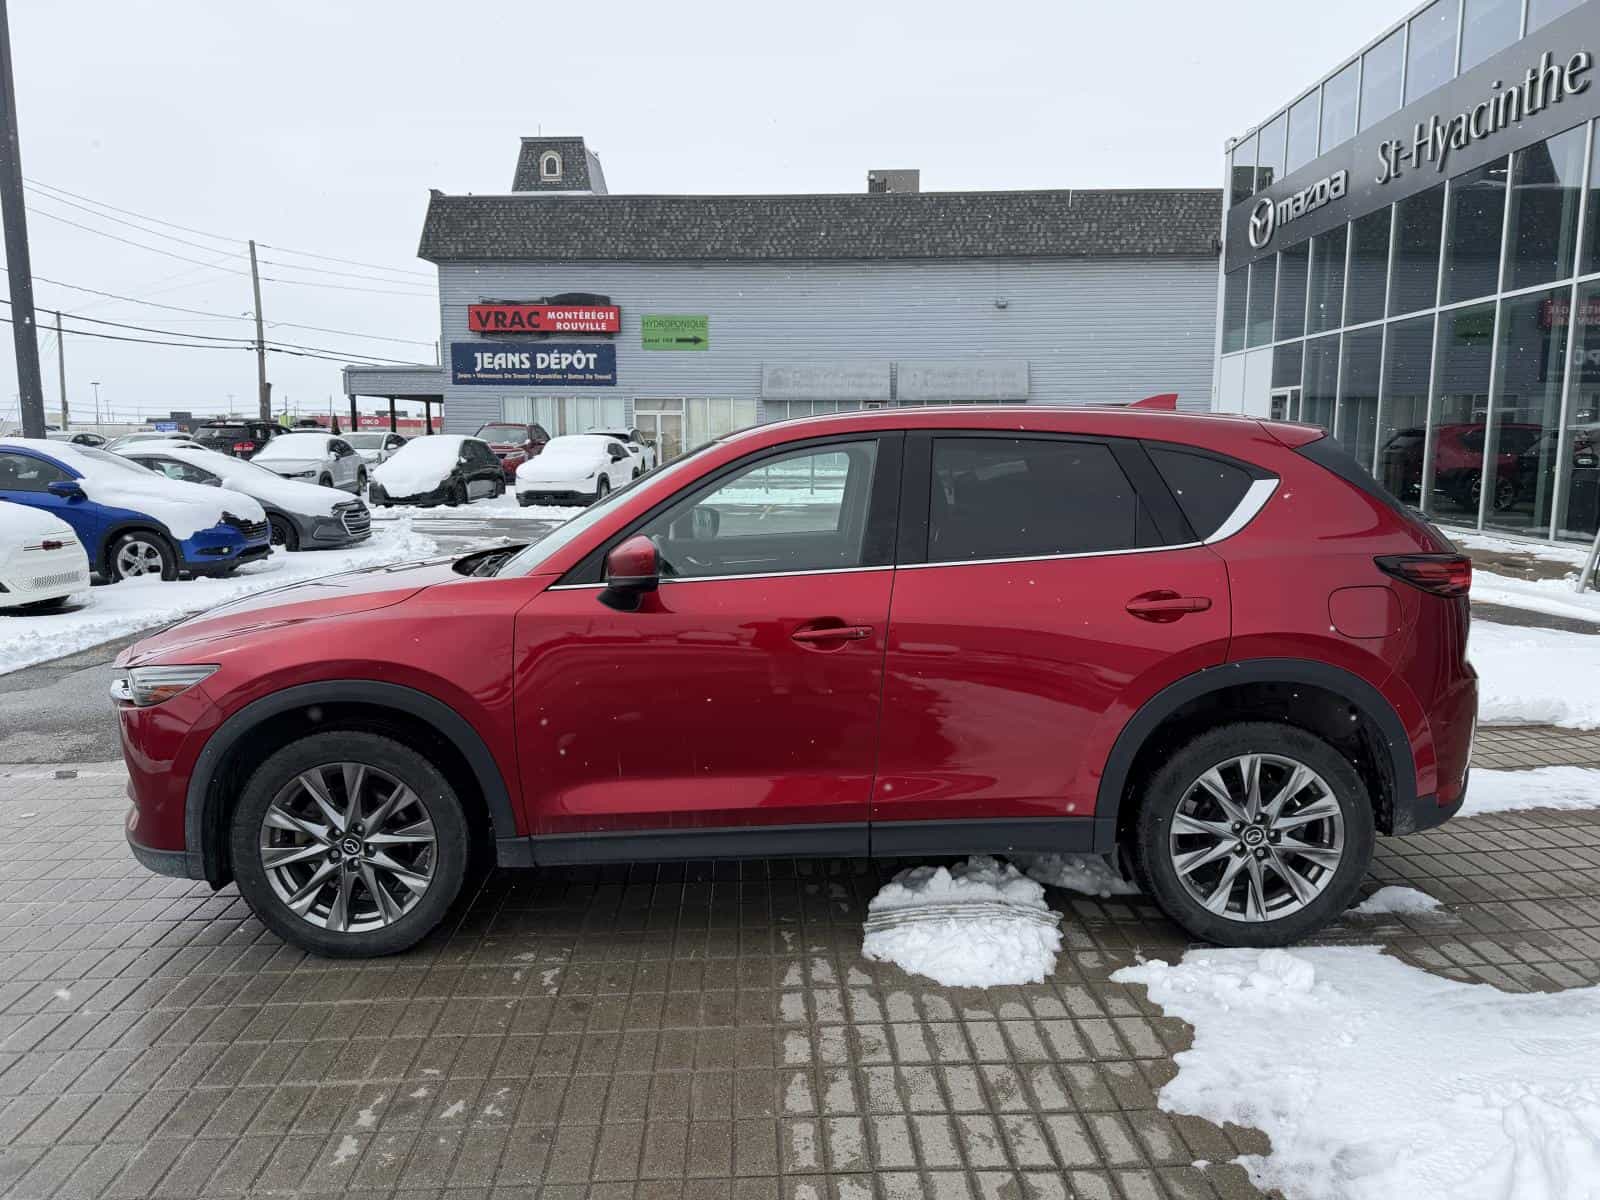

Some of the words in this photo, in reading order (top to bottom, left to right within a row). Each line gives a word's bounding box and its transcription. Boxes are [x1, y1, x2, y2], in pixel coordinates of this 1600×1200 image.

[1375, 50, 1593, 185] St-Hyacinthe
[475, 310, 541, 329] VRAC
[547, 309, 615, 320] MONTÉRÉGIE
[555, 322, 607, 331] ROUVILLE
[642, 319, 707, 329] HYDROPONIQUE
[474, 352, 531, 372] JEANS
[535, 349, 598, 370] DÉPÔT
